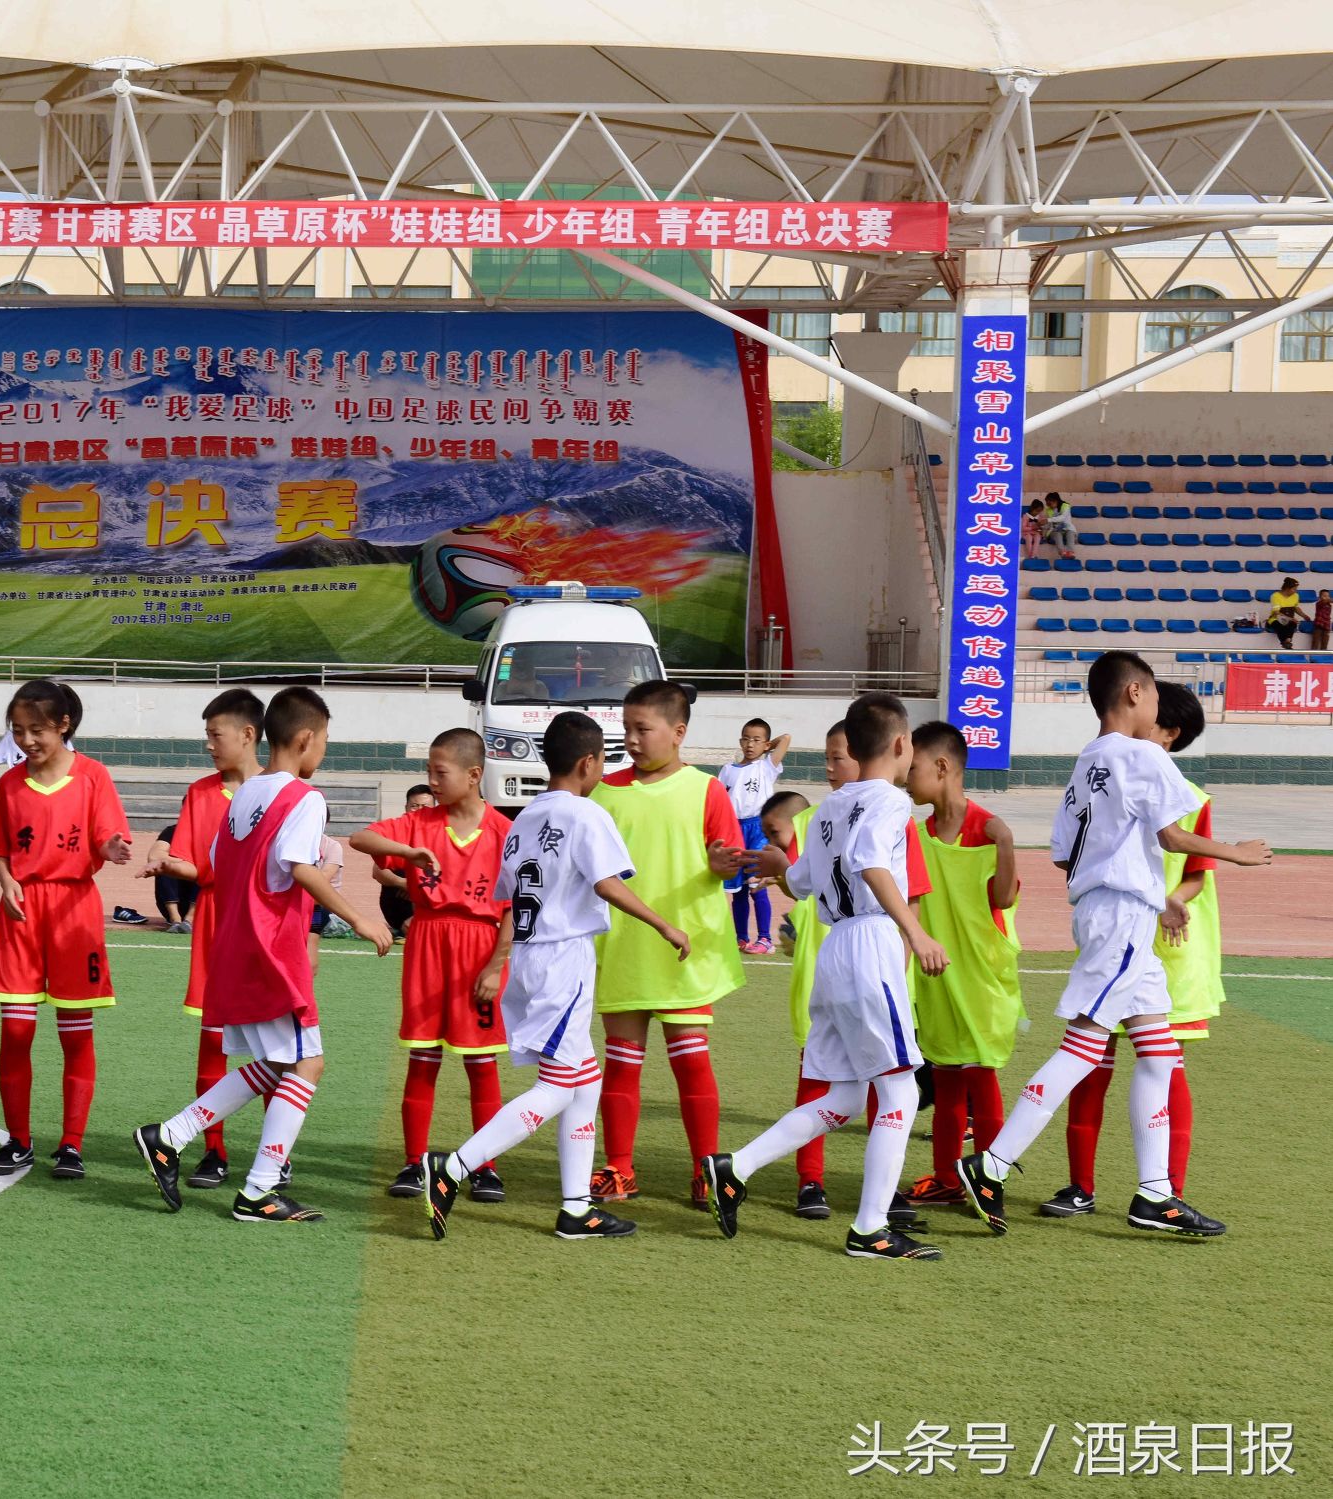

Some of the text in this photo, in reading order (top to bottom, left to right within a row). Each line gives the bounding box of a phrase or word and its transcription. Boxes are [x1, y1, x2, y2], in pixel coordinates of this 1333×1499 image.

[20, 479, 358, 549] 总决赛
[960, 328, 1016, 749] 相聚雪山草原足球运动传递友谊
[511, 858, 544, 944] 6
[87, 952, 100, 984] 6
[477, 1000, 494, 1029] 9
[874, 1119, 904, 1130] adidas
